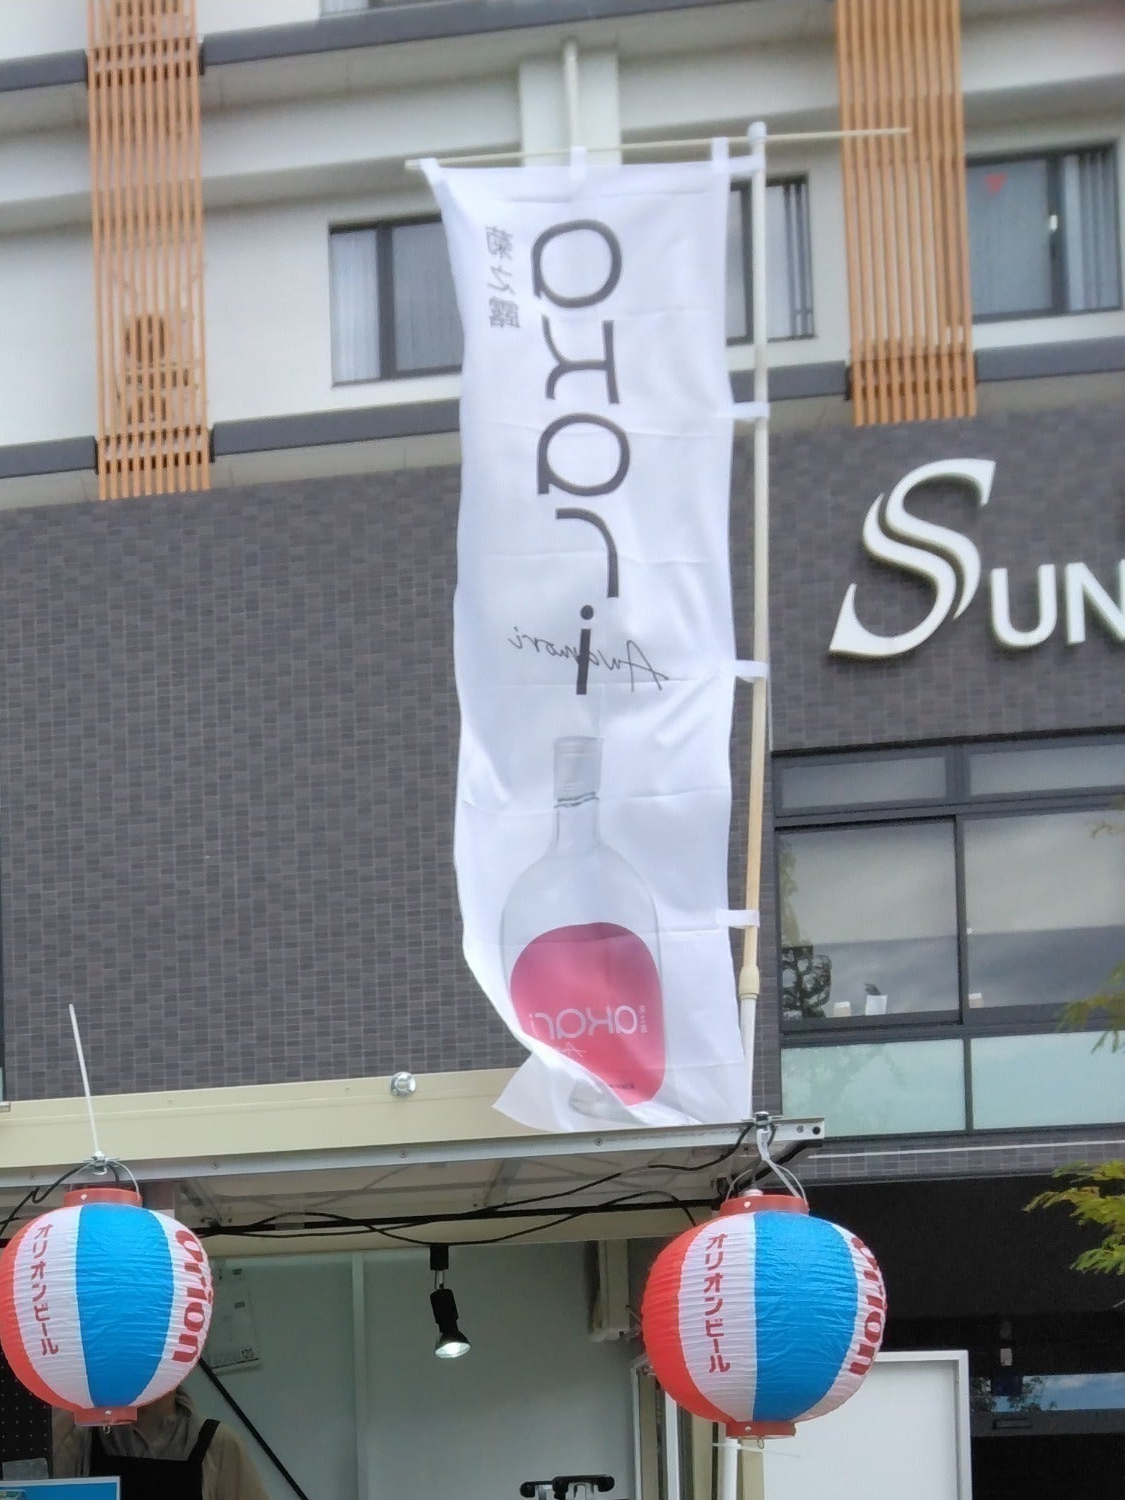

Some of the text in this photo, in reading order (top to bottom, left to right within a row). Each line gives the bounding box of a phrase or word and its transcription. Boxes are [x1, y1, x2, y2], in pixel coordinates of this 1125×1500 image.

[30, 1223, 59, 1356] オリオンビール
[171, 1229, 213, 1363] Orion
[703, 1233, 730, 1373] オリオンビール
